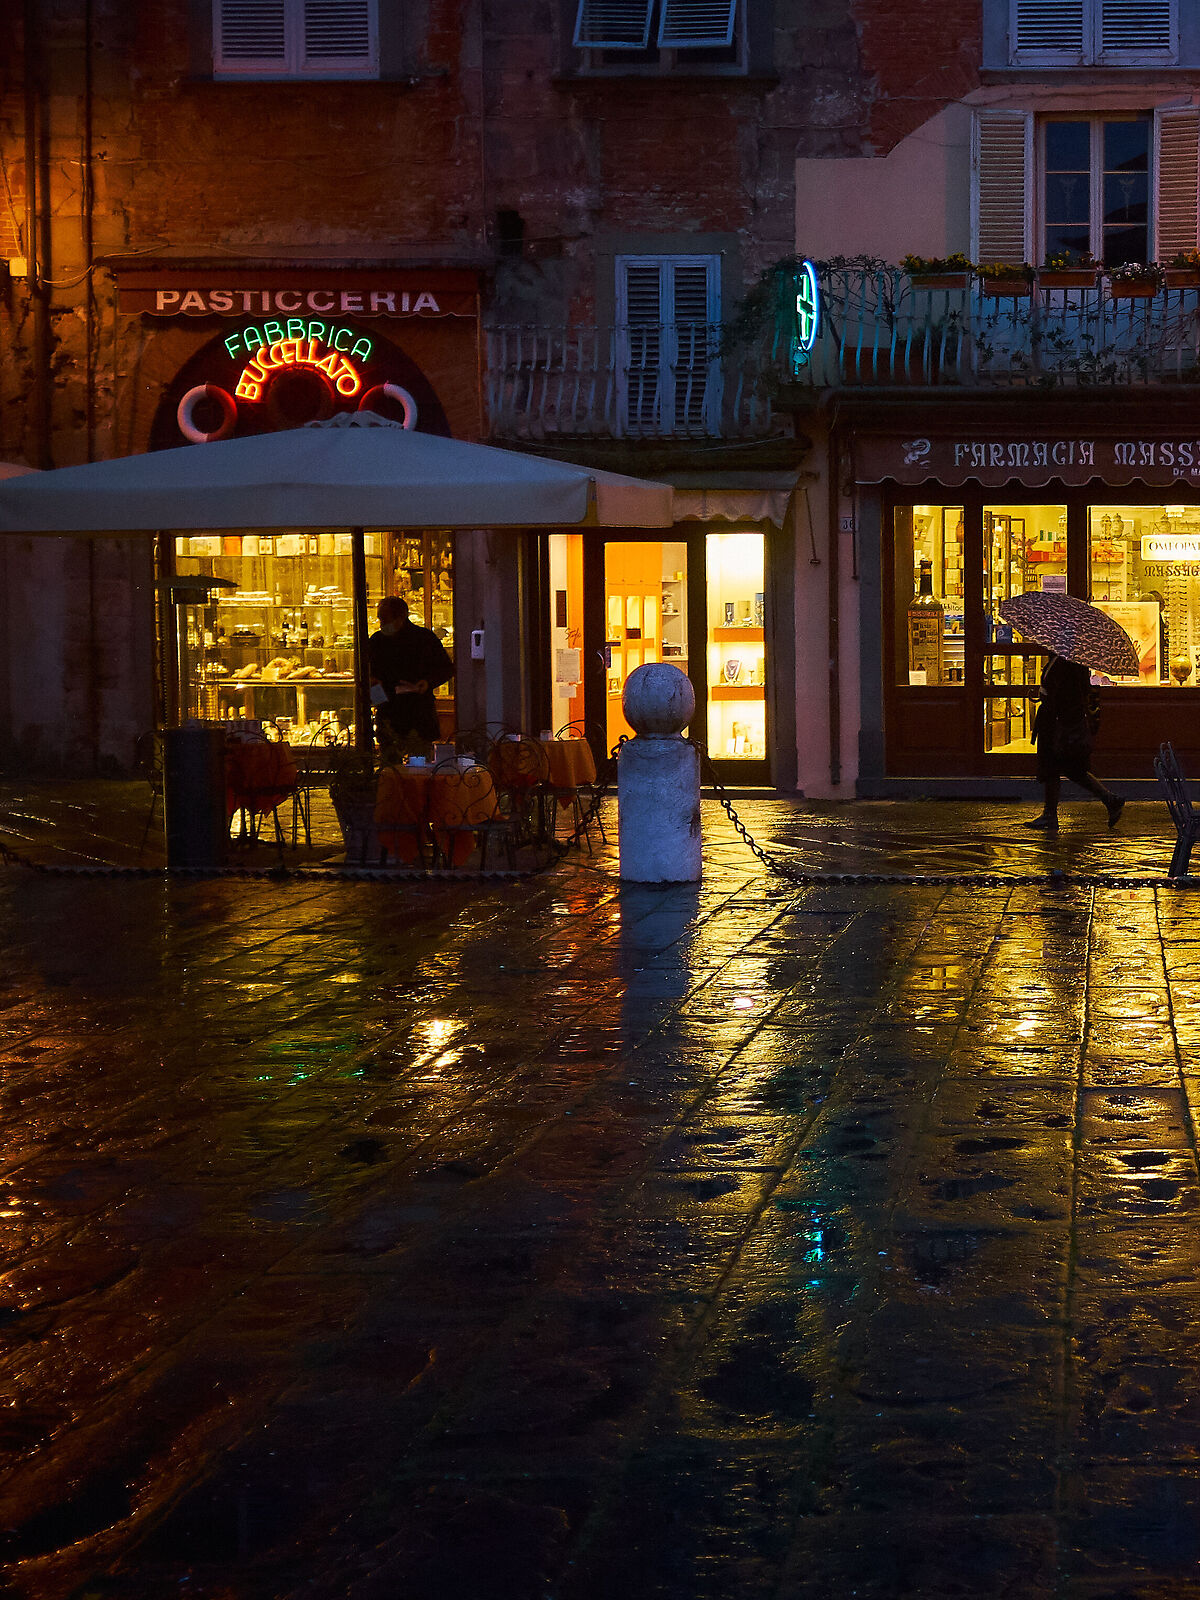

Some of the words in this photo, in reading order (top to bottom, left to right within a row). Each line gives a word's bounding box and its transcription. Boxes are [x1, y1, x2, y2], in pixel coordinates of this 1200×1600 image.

[156, 291, 440, 311] PASTICCERIA
[224, 318, 371, 362] FABBRICA
[235, 340, 359, 400] BUCCELLATO
[953, 441, 1095, 467] FARMACIA
